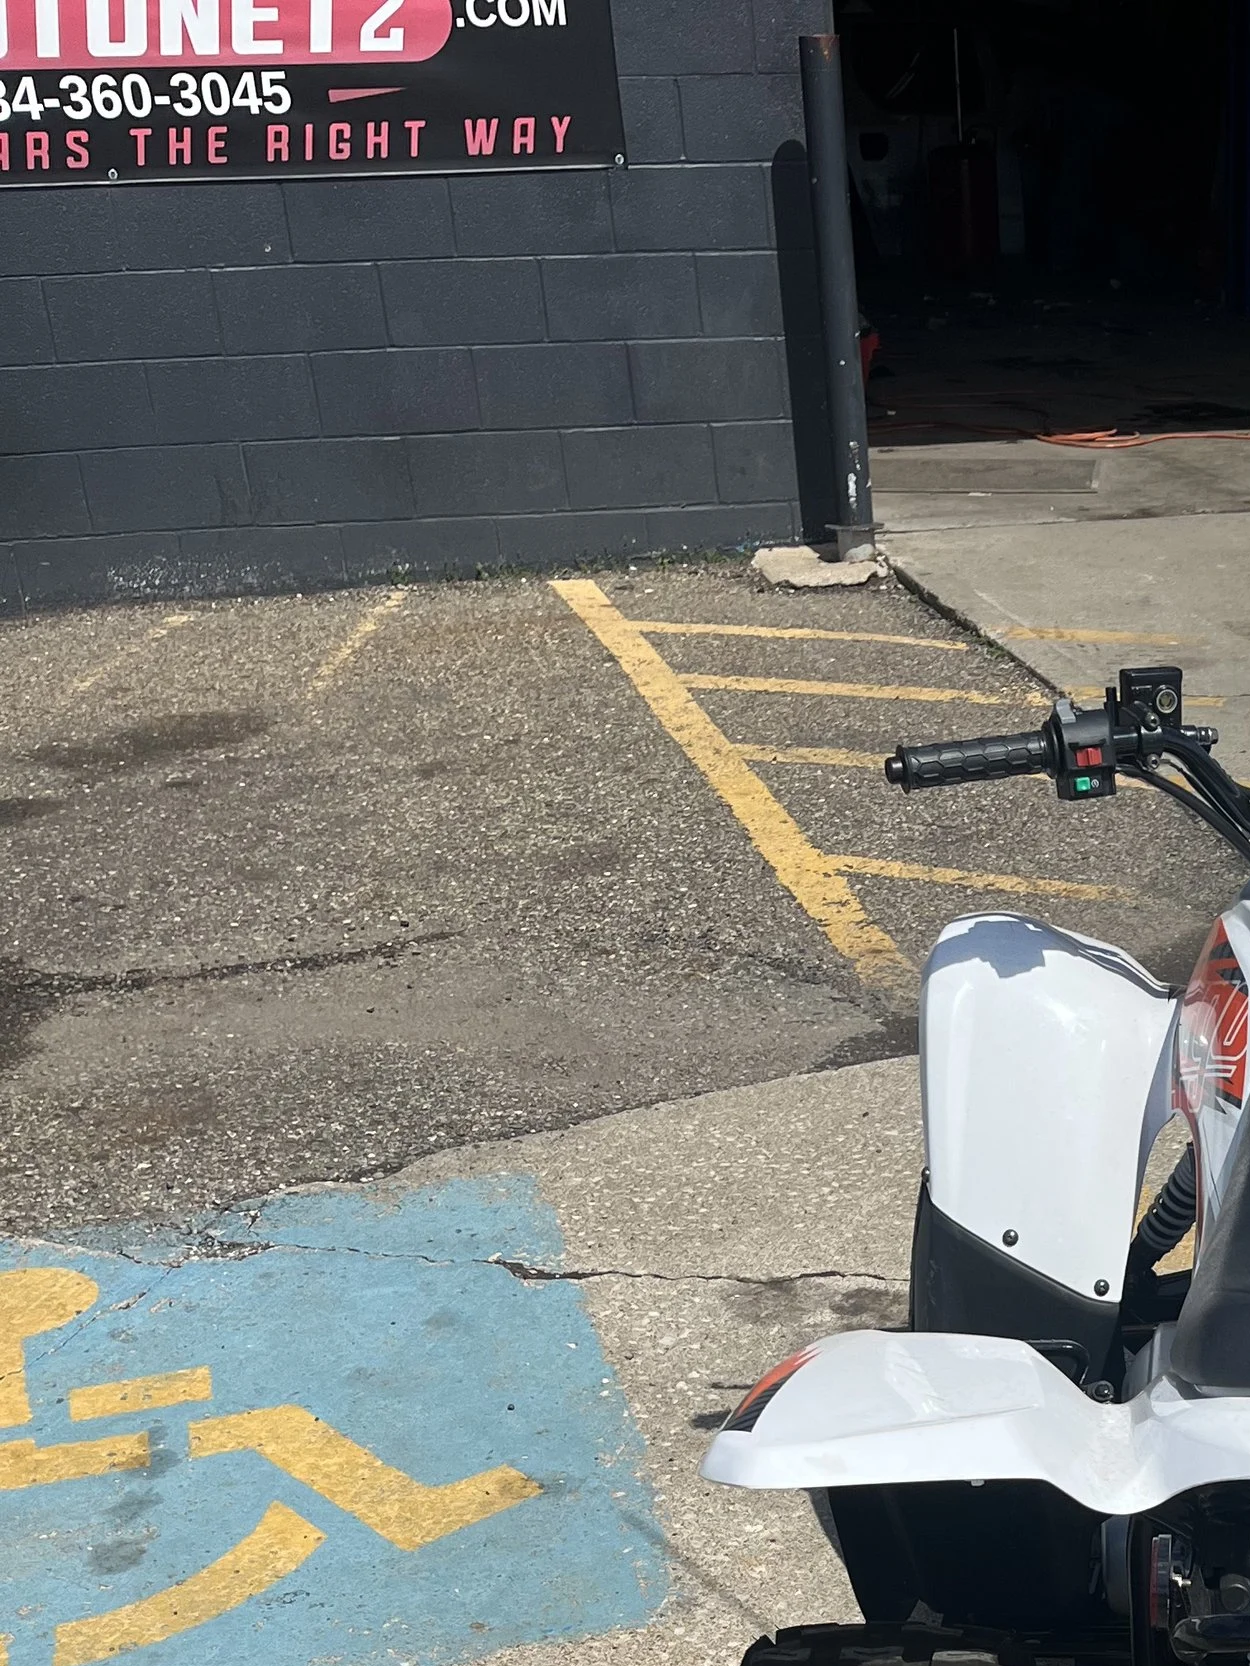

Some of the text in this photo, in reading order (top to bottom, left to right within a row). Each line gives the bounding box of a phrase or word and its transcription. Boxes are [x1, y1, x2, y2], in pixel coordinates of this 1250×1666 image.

[455, 0, 567, 28] .COM
[129, 126, 228, 166] THE
[266, 120, 426, 163] RIGHT
[464, 115, 571, 157] WAY
